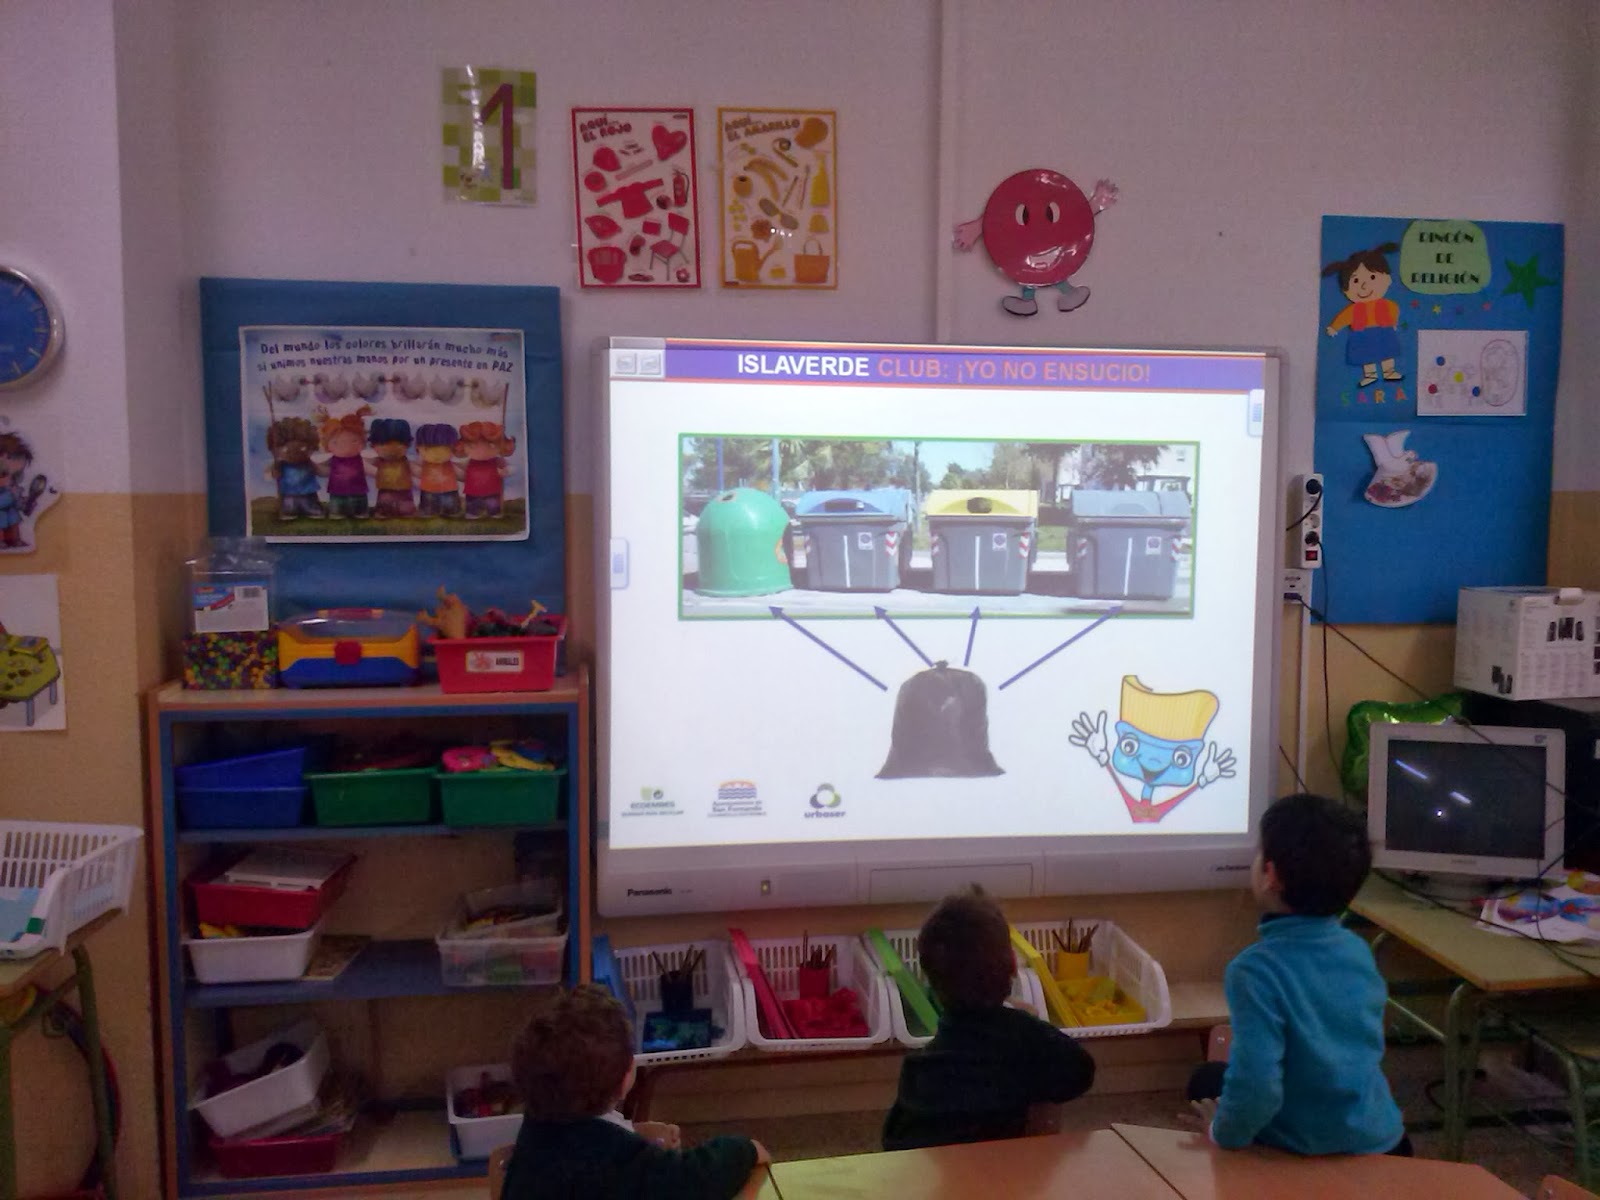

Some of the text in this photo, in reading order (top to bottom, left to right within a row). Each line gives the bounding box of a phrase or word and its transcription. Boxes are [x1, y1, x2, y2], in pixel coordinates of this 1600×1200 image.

[475, 83, 513, 190] 1
[582, 123, 632, 143] EL ROJO
[744, 119, 800, 137] AMARILLO
[1419, 230, 1475, 244] RINCÓN
[1435, 252, 1454, 264] DE
[1410, 270, 1480, 284] RELIGIÓN
[260, 338, 509, 359] Del mundo los colores brillarán mucho más
[257, 355, 514, 373] si unimos nuestras manos por un presente en PAZ
[737, 353, 1150, 384] ISLAVERDE CLUB: ¡YO NO ENSUCIO!
